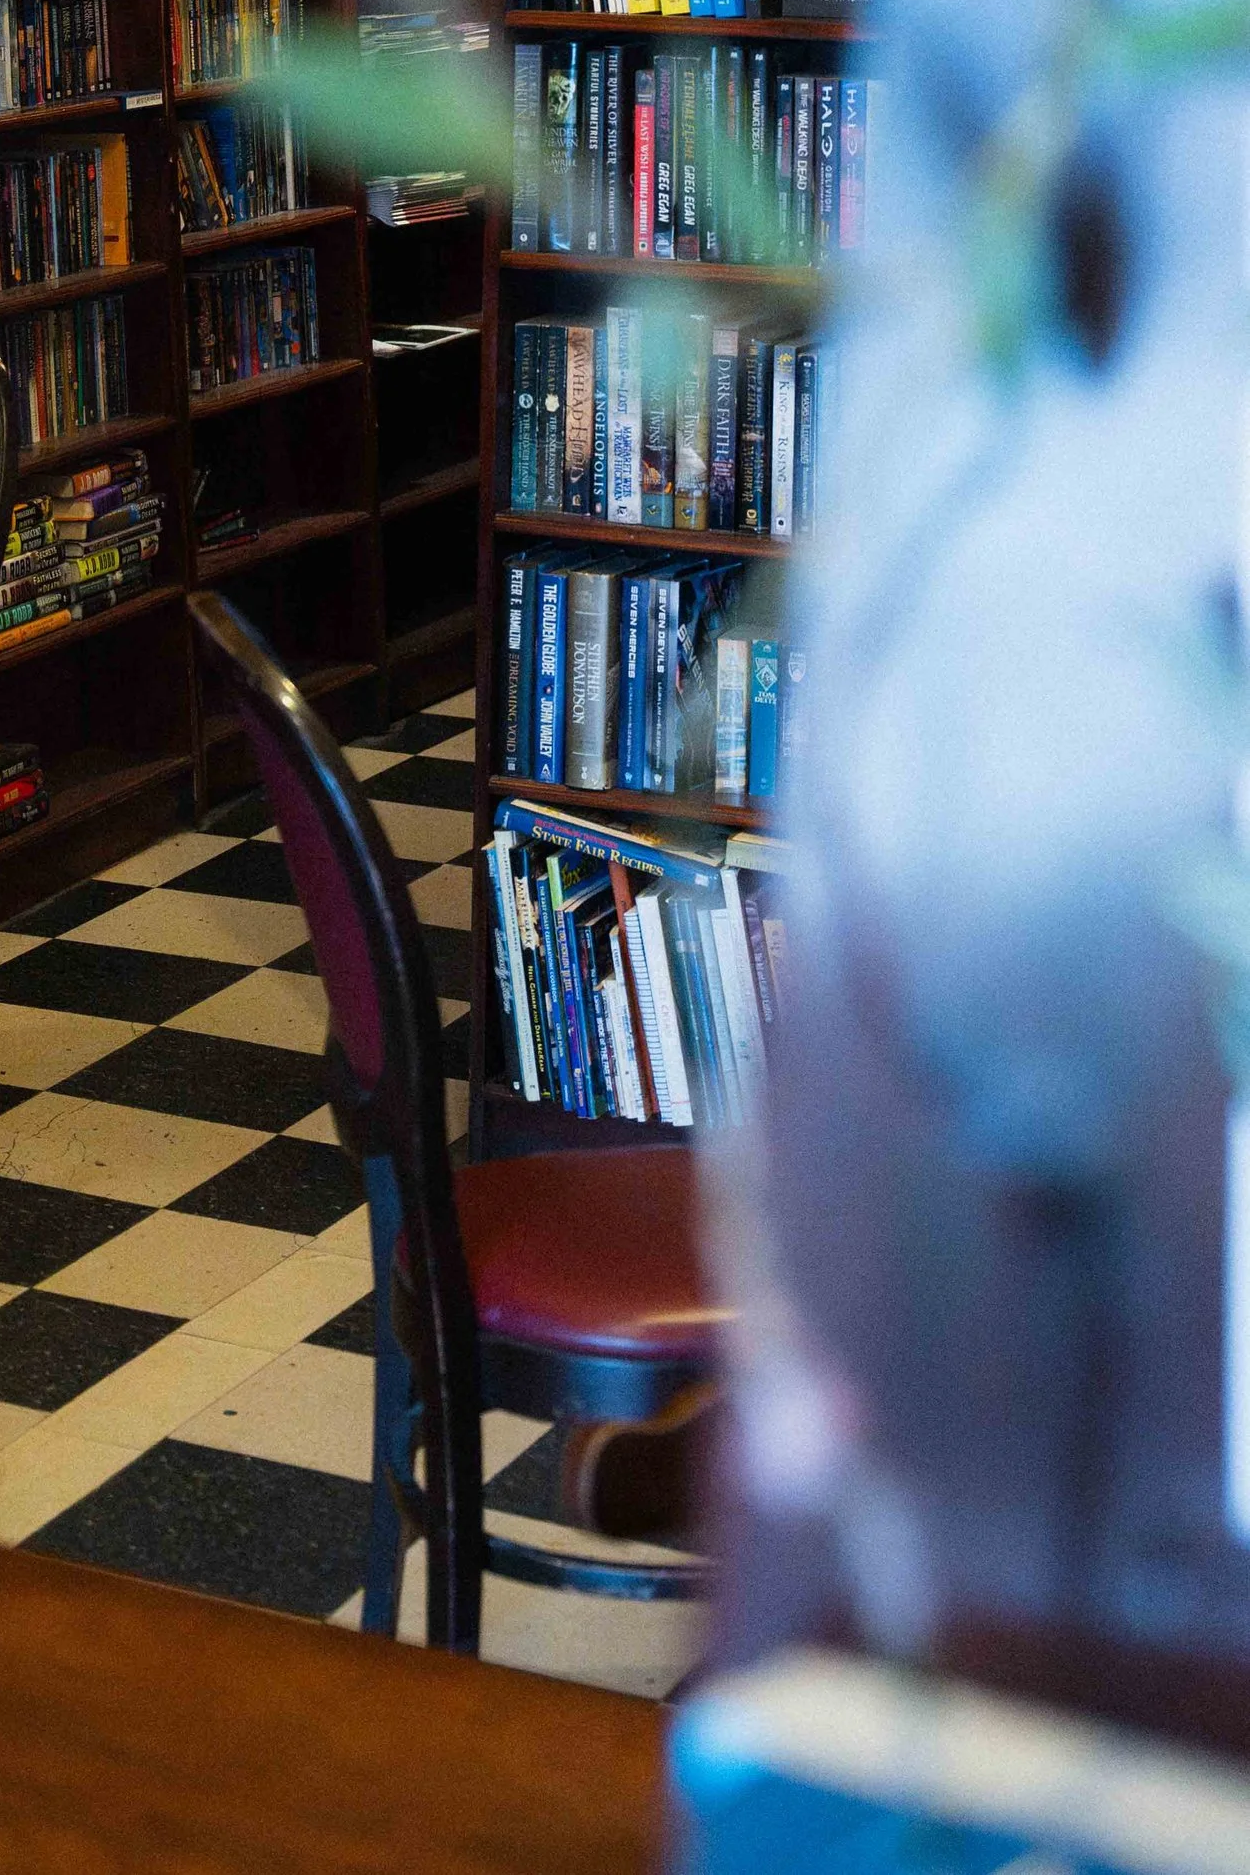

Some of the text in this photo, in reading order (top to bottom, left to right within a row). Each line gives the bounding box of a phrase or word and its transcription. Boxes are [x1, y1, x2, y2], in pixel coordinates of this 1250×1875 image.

[590, 58, 599, 93] FEARFUL
[589, 95, 599, 150] SYMMETRIES
[607, 53, 618, 165] THE RIVER OF SILVER
[752, 89, 760, 150] WALKING DEAD
[821, 86, 833, 158] HALO
[846, 89, 858, 156] HALO
[639, 118, 649, 169] LAST WISH
[683, 71, 695, 225] ETERNAL GREG EGAN
[797, 109, 809, 190] WALKING DEAD
[658, 162, 670, 223] GREG EGAN
[824, 166, 832, 212] OBLIVION
[572, 337, 585, 421] LAWHEAD
[617, 389, 628, 414] LOST
[716, 358, 731, 455] DARK FAITH
[746, 358, 757, 421] HICKMAN
[521, 414, 529, 431] THE
[593, 389, 606, 496] ANGELOPOLIS
[683, 412, 699, 448] TWINS
[777, 380, 789, 483] KING RISING
[521, 462, 529, 488] HAND
[614, 429, 623, 501] TRACY HICKMAN
[622, 426, 632, 498] MARGARET WEIS
[9, 546, 57, 578] ROBB SECRETS
[33, 568, 62, 585] FAITHLESS
[85, 552, 116, 575] J.D. ROBB
[511, 569, 523, 595] PETER
[12, 603, 33, 625] ROBB
[509, 609, 522, 649] HAMILTON
[627, 586, 638, 678] SEVEN MERCIES
[656, 588, 667, 673] SEVEN DEVILS
[539, 585, 557, 758] THE GOLDEN GLOBE JOHN VARLEY
[572, 641, 586, 725] DONALDSON
[587, 643, 601, 702] STEPHEN
[677, 623, 707, 687] SEVEN
[507, 660, 519, 721] DREAMING
[758, 691, 775, 699] TOM
[506, 724, 517, 752] VOID
[532, 825, 572, 849] STATE
[574, 837, 605, 861] FAIR
[609, 849, 664, 878] RECIPES
[544, 931, 554, 970] CELEBRATIONS
[549, 971, 558, 1002] COOKBOOK
[555, 1023, 563, 1040] CRAIG
[529, 982, 537, 1009] GAIMAN
[536, 1043, 544, 1072] McKEAN
[596, 1017, 613, 1091] BRIDE of THE FAR SIDE
